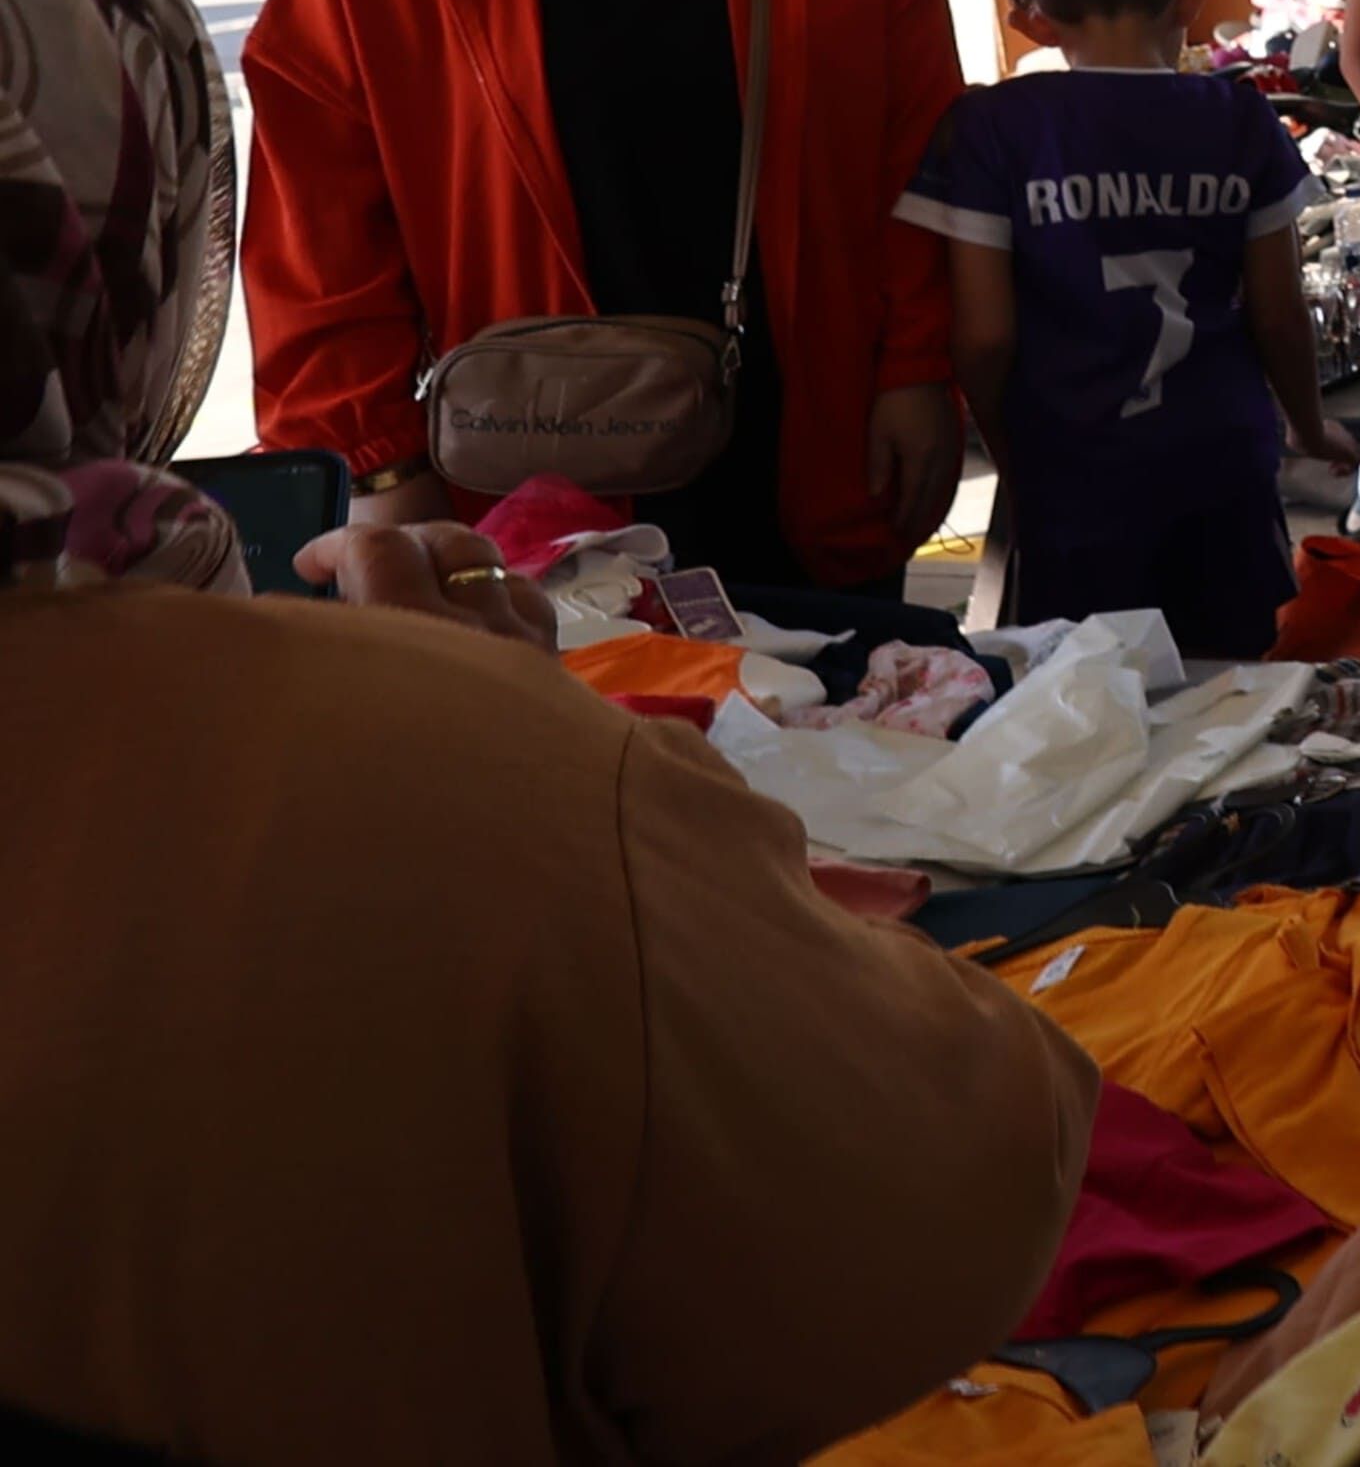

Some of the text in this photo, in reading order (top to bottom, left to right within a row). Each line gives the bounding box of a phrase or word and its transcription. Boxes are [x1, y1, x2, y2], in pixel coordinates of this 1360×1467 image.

[1026, 172, 1250, 226] RONALDO
[1102, 248, 1194, 418] 7
[452, 409, 679, 436] Calvin Klein Jeans
